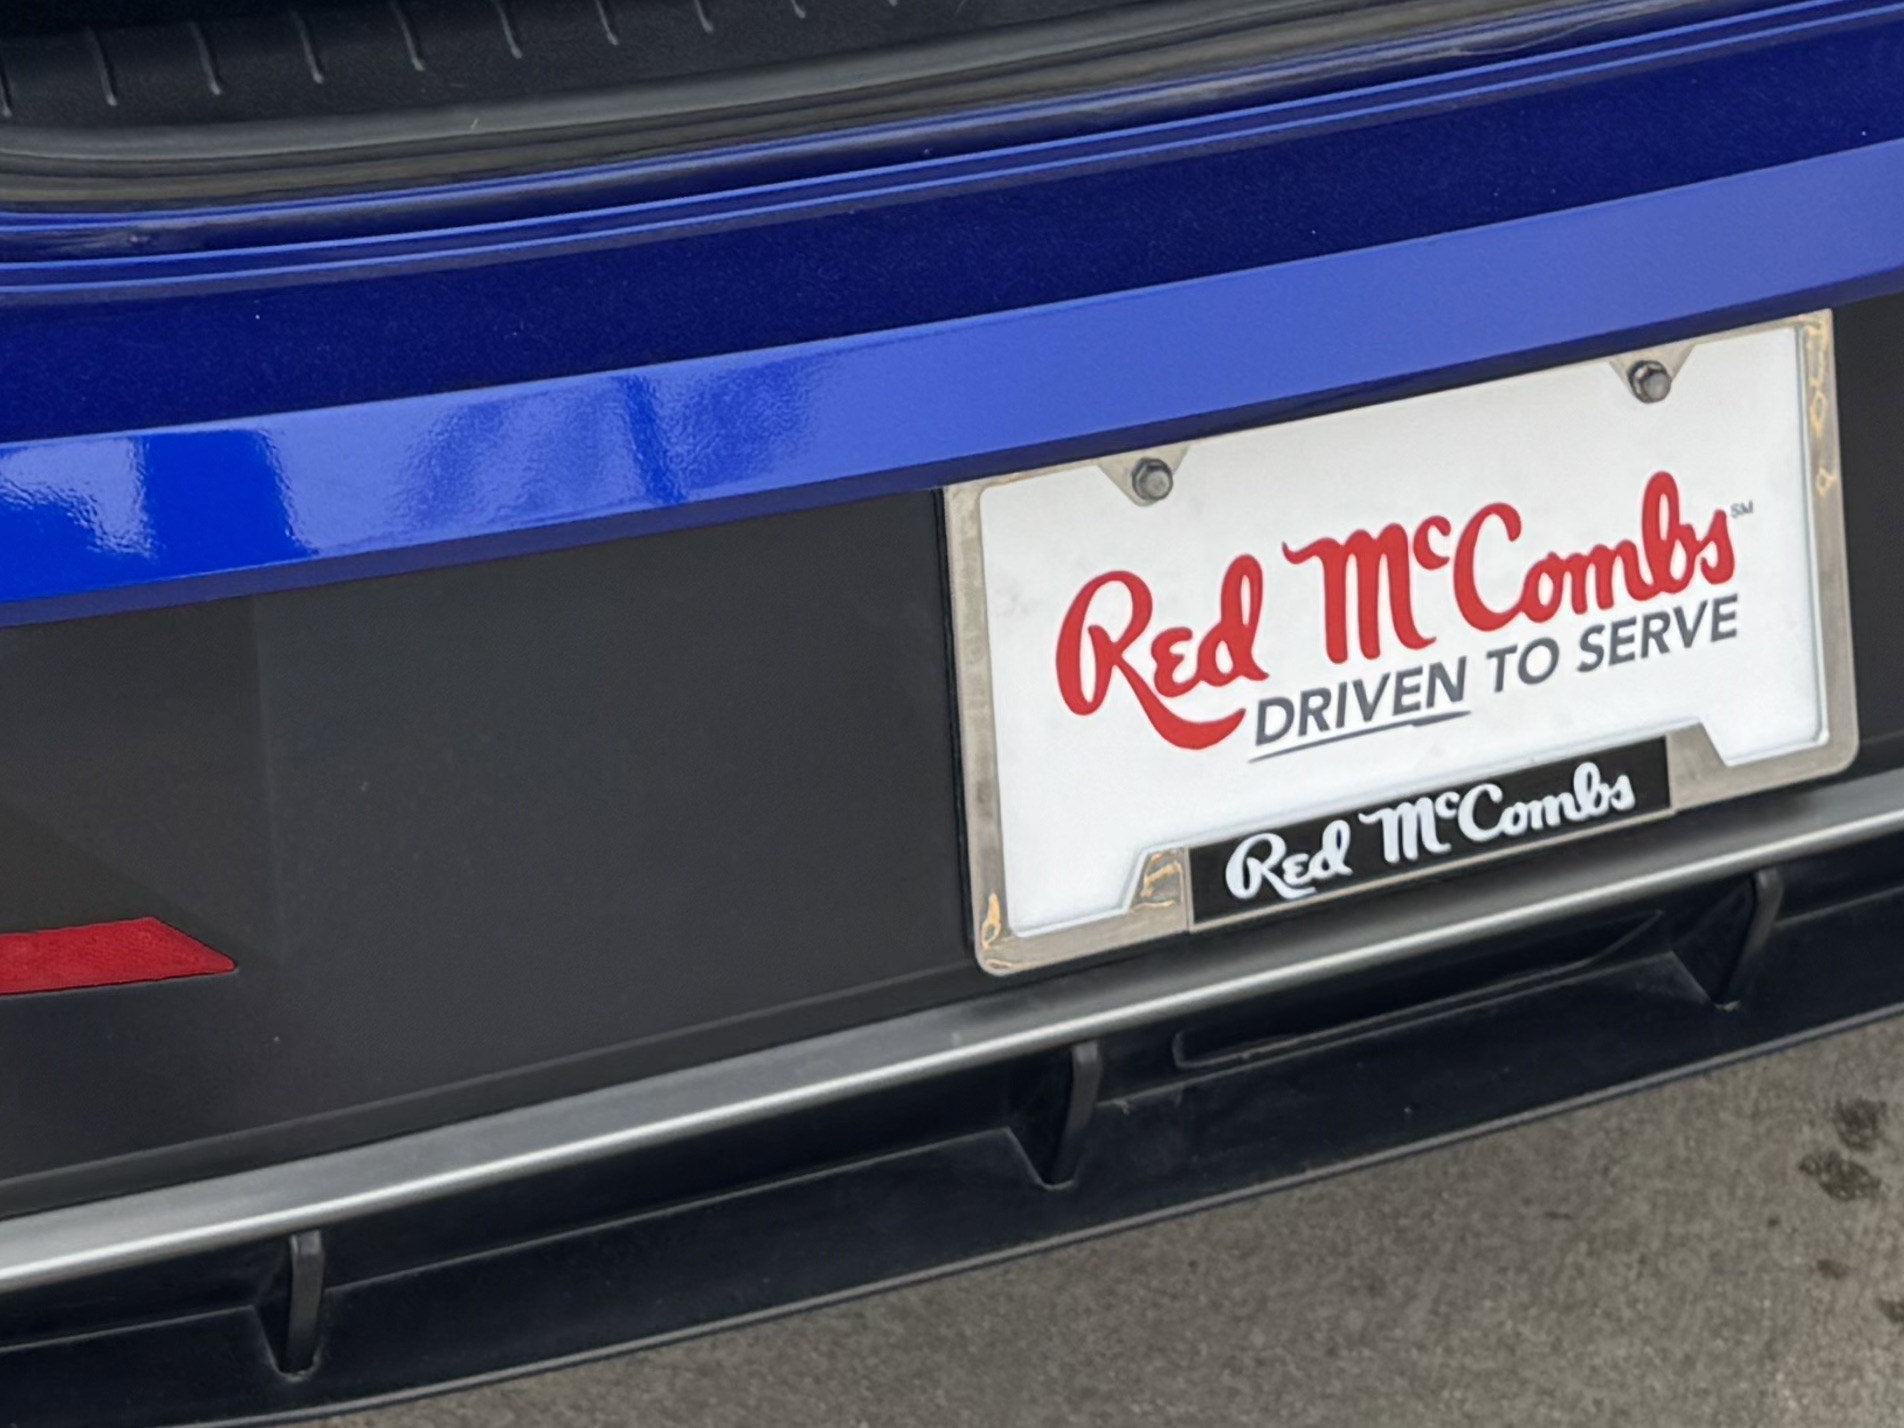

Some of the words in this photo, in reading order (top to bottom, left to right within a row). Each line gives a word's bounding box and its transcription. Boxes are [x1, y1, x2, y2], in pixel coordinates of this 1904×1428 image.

[1056, 554, 1268, 750] Red
[1283, 471, 1735, 664] McCombs
[1256, 656, 1467, 747] DRIVEN
[1486, 637, 1560, 693] TO
[1578, 594, 1739, 674] SERVE
[1226, 821, 1352, 900] Red
[1359, 762, 1636, 863] McCombs
